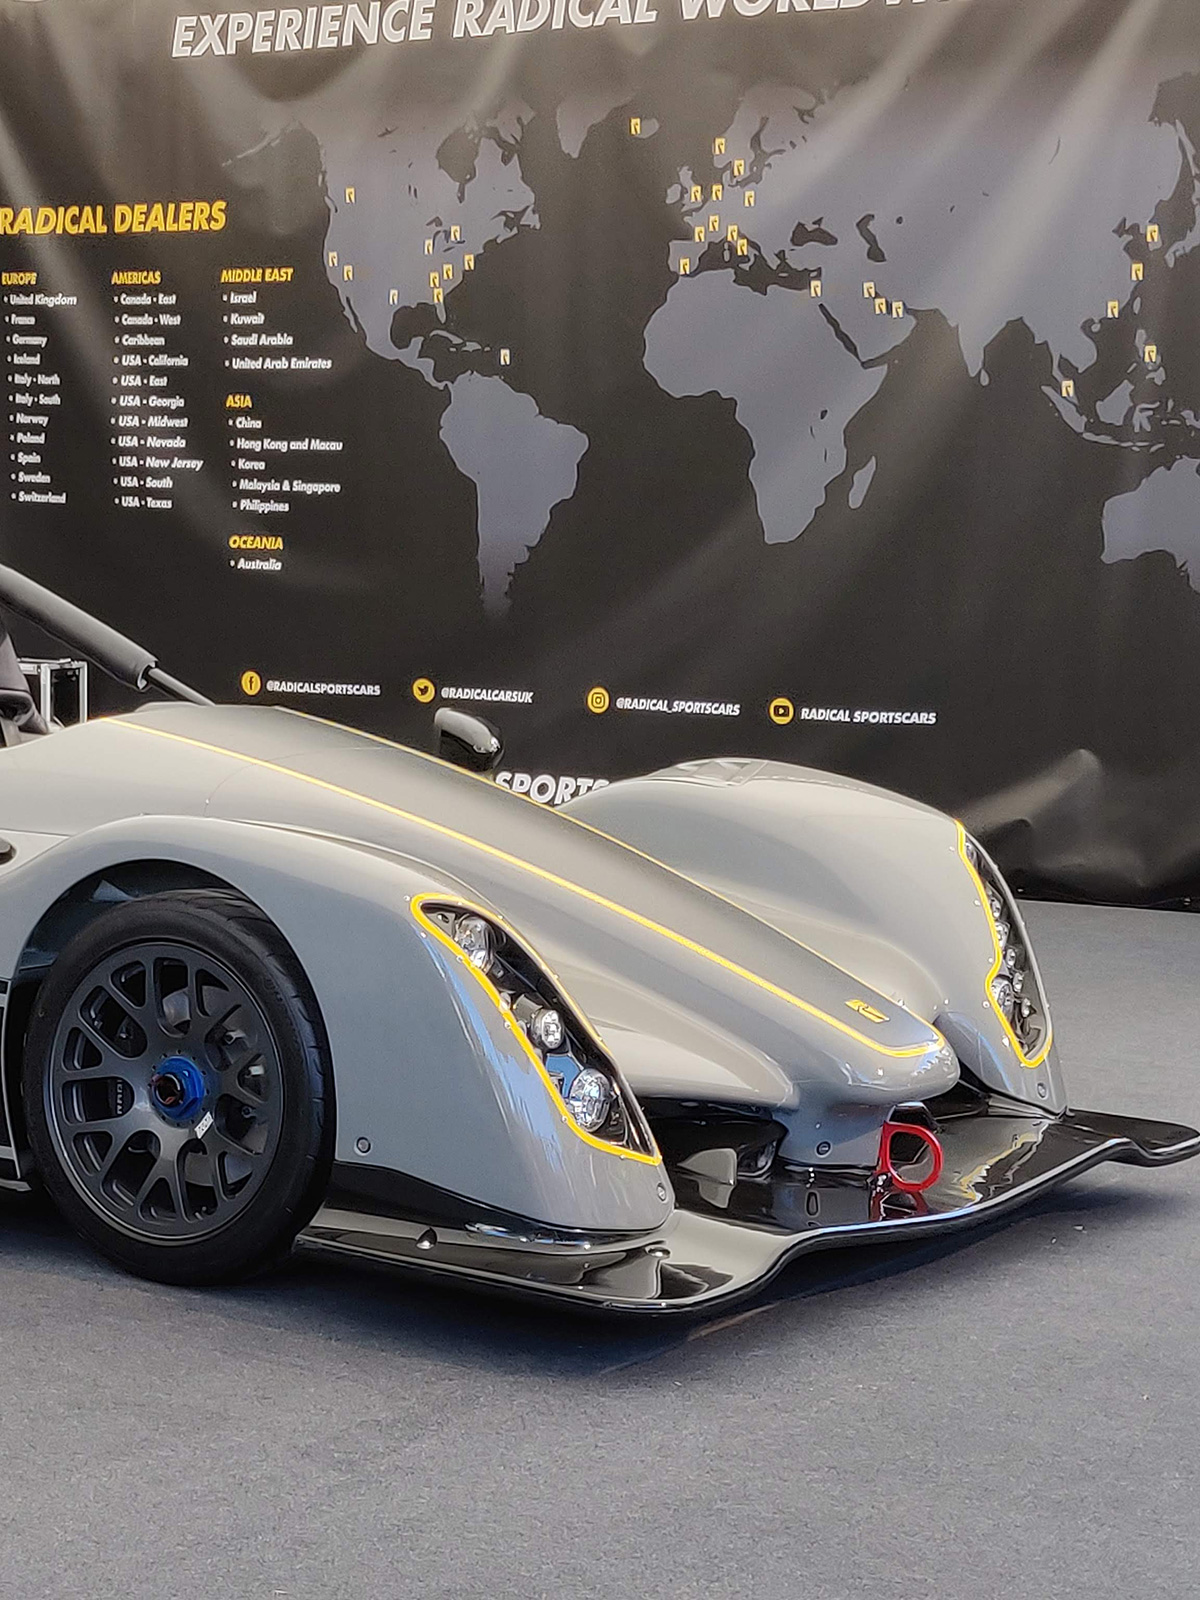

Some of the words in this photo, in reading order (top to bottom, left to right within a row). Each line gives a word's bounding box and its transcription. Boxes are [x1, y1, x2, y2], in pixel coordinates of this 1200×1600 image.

[171, 0, 436, 59] EXPERIENCE
[452, 0, 658, 39] RADICAL
[113, 201, 228, 233] DEALERS
[2, 272, 37, 285] EUROPE
[111, 271, 161, 285] AMERICAS
[221, 268, 263, 283] MIDDLE
[264, 267, 294, 281] EAST
[10, 293, 34, 306] United
[35, 293, 77, 308] Kingdom
[120, 293, 152, 305] Canada
[158, 293, 176, 305] East
[230, 290, 257, 304] Israel
[11, 313, 35, 325] France
[121, 313, 153, 325] Canada
[159, 313, 181, 325] West
[230, 312, 265, 325] Kuwait
[12, 333, 48, 348] Germany
[121, 333, 165, 346] Caribbean
[230, 333, 258, 346] Saudi
[259, 332, 294, 346] Arabia
[121, 354, 142, 366] USA
[148, 354, 189, 366] California
[232, 356, 262, 370] United
[263, 356, 289, 370] Arab
[290, 356, 333, 370] Emirates
[14, 373, 32, 387] Italy
[37, 373, 60, 385] North
[120, 375, 142, 387] USA
[149, 375, 168, 387] East
[15, 392, 33, 406] Italy
[39, 393, 60, 405] South
[119, 395, 141, 407] USA
[148, 395, 185, 410] Georgia
[226, 394, 253, 409] ASIA
[16, 412, 49, 427] Norway
[118, 415, 140, 427] USA
[147, 414, 189, 428] Midwest
[235, 416, 262, 429] China
[17, 432, 45, 444] Poland
[118, 435, 139, 447] USA
[146, 436, 186, 448] Nevada
[236, 437, 261, 452] Hong
[263, 438, 288, 453] Kong
[289, 438, 309, 451] and
[310, 438, 344, 451] Macau
[17, 451, 41, 465] Spain
[119, 455, 138, 468] USA
[145, 456, 170, 469] New
[171, 456, 204, 472] Jersey
[238, 458, 266, 471] Korea
[18, 471, 51, 484] Sweden
[120, 476, 139, 488] USA
[145, 476, 173, 489] South
[239, 478, 281, 494] Malaysia
[282, 479, 291, 492] &
[292, 479, 342, 495] Singapore
[18, 490, 67, 504] Switzerland
[121, 496, 140, 508] USA
[146, 496, 173, 509] Texas
[240, 498, 290, 514] Philippines
[228, 534, 284, 550] OCEANIA
[237, 557, 282, 571] Australia
[266, 680, 381, 696] @RADICALSPORTSCARS
[441, 687, 534, 704] @RADICALCARSUK
[615, 697, 740, 716] @RADICAL_SPORTSCARS
[800, 707, 851, 723] RADICAL
[852, 710, 937, 725] SPORTSCARS
